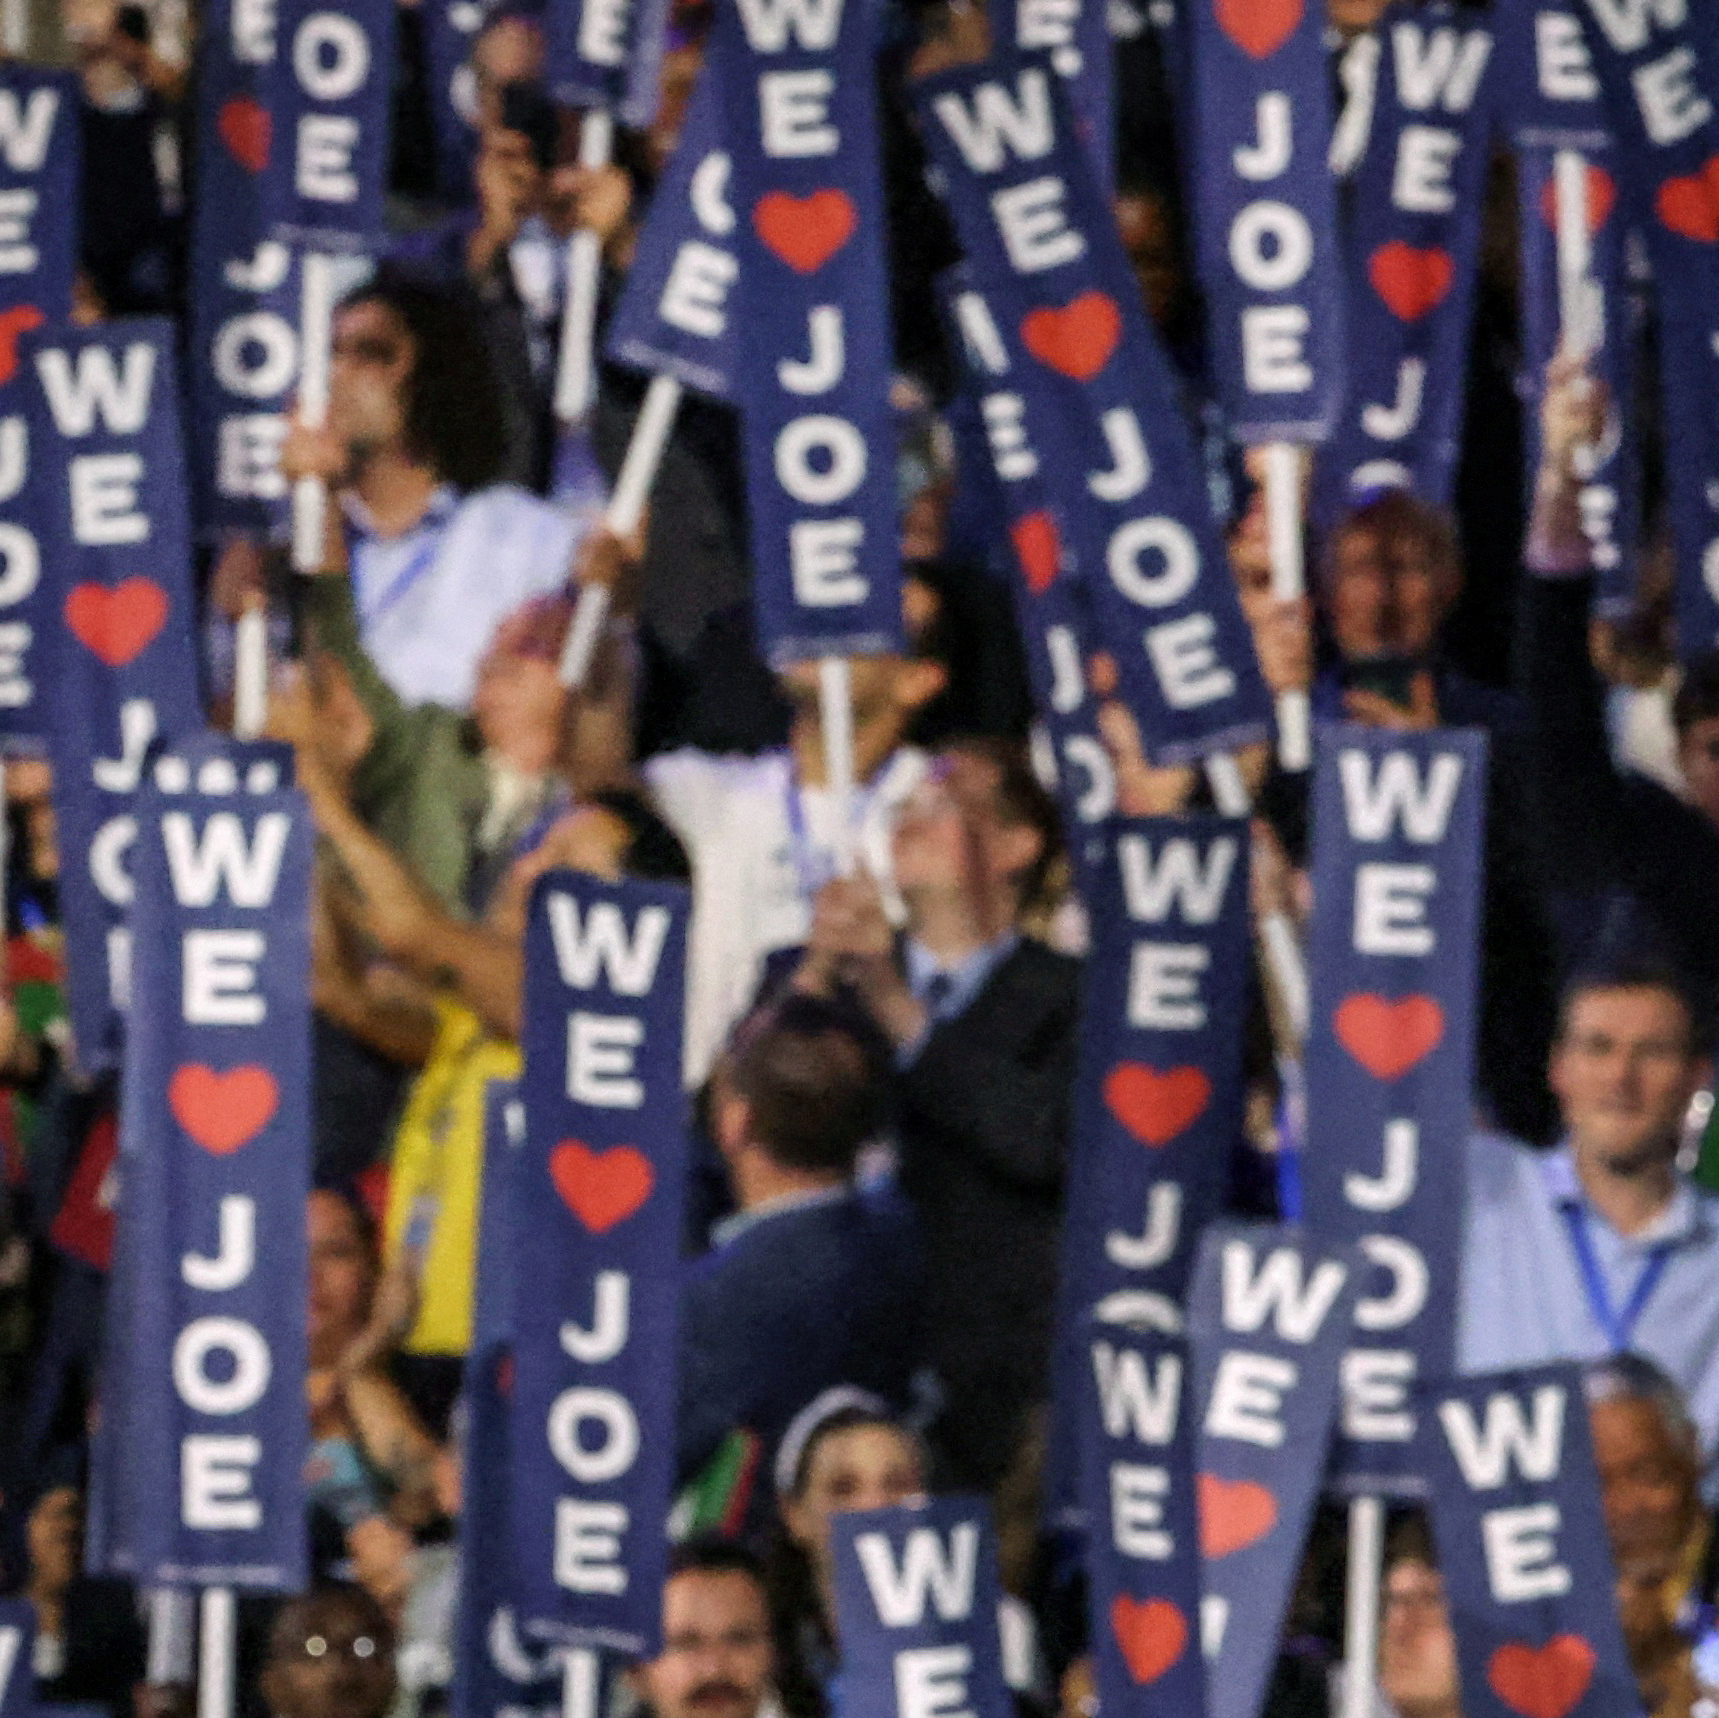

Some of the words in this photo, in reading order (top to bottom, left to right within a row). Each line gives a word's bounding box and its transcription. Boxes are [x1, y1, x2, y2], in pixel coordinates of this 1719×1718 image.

[739, 0, 840, 156] WE
[1395, 26, 1488, 209] WE
[1230, 92, 1313, 393] JOE
[38, 343, 155, 544] WE
[776, 307, 867, 605] JOE
[939, 73, 1082, 270] WE
[1091, 410, 1232, 706] JOE
[161, 811, 292, 1026] WE
[1121, 838, 1232, 1027] WE
[1338, 749, 1462, 955] WE
[549, 894, 668, 1107] WE
[173, 1194, 271, 1529] JOE
[1203, 1239, 1348, 1449] WE
[1338, 1120, 1428, 1440] JOE
[549, 1272, 638, 1592] JOE
[1095, 1346, 1179, 1559] WE
[1439, 1386, 1570, 1602] WE
